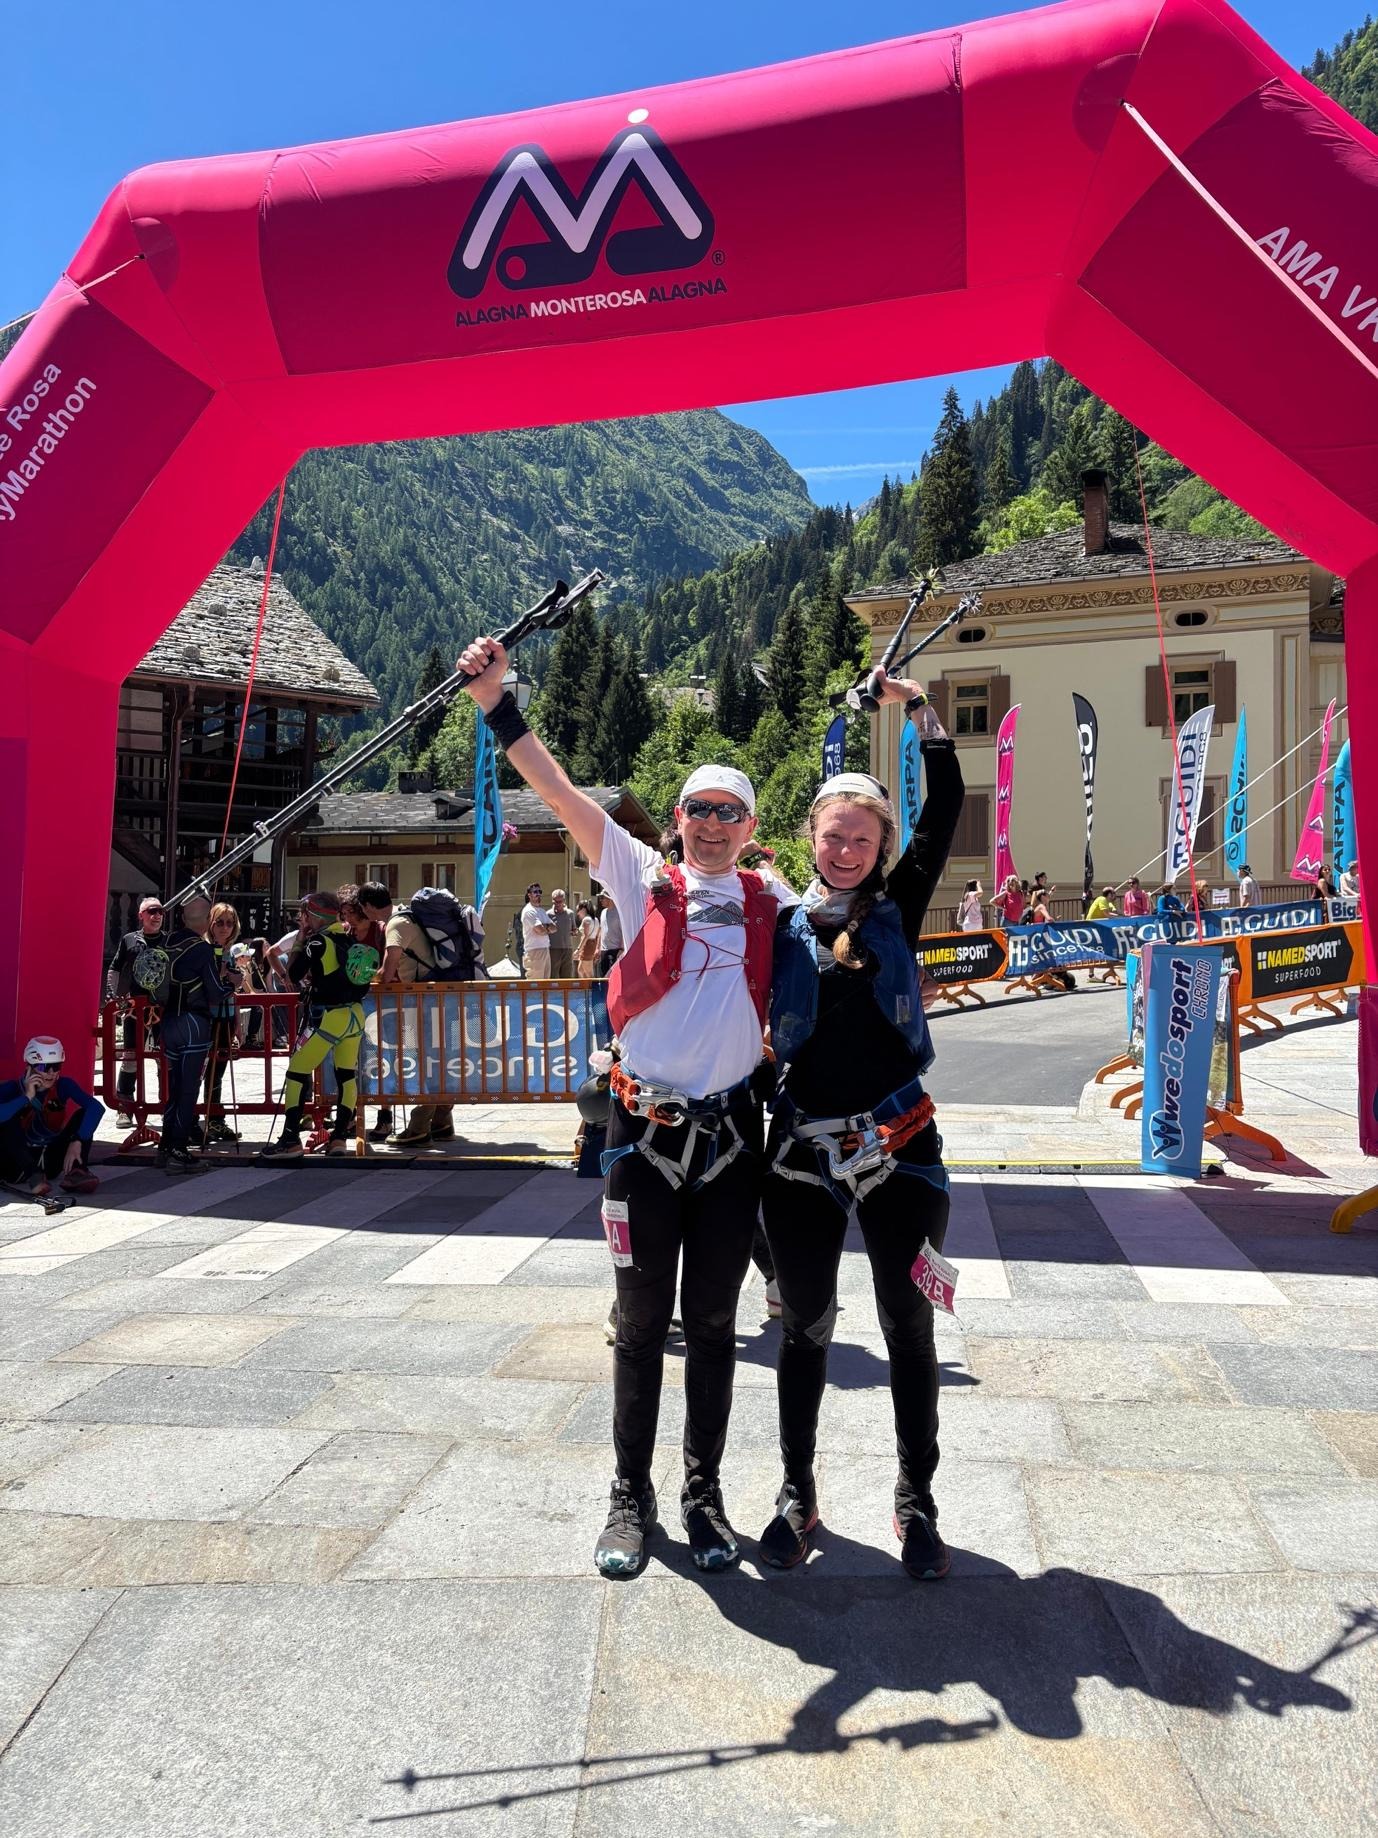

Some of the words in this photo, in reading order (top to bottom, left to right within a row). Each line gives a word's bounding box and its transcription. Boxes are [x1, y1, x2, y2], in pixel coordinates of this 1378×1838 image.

[1255, 226, 1340, 300] AMA
[6, 363, 62, 431] Rosa
[0, 377, 97, 521] yMarathon
[904, 739, 918, 830] ARPA
[1334, 780, 1346, 874] ARPA
[1136, 919, 1207, 942] GUIDI
[1244, 907, 1316, 932] GUIDI
[924, 943, 989, 966] NAMEDSPORT
[1267, 940, 1338, 969] NAMEDSPORT
[1275, 966, 1321, 984] SUPERFOOD
[1191, 959, 1213, 1020] CHRONO
[1159, 957, 1194, 1122] wedosport
